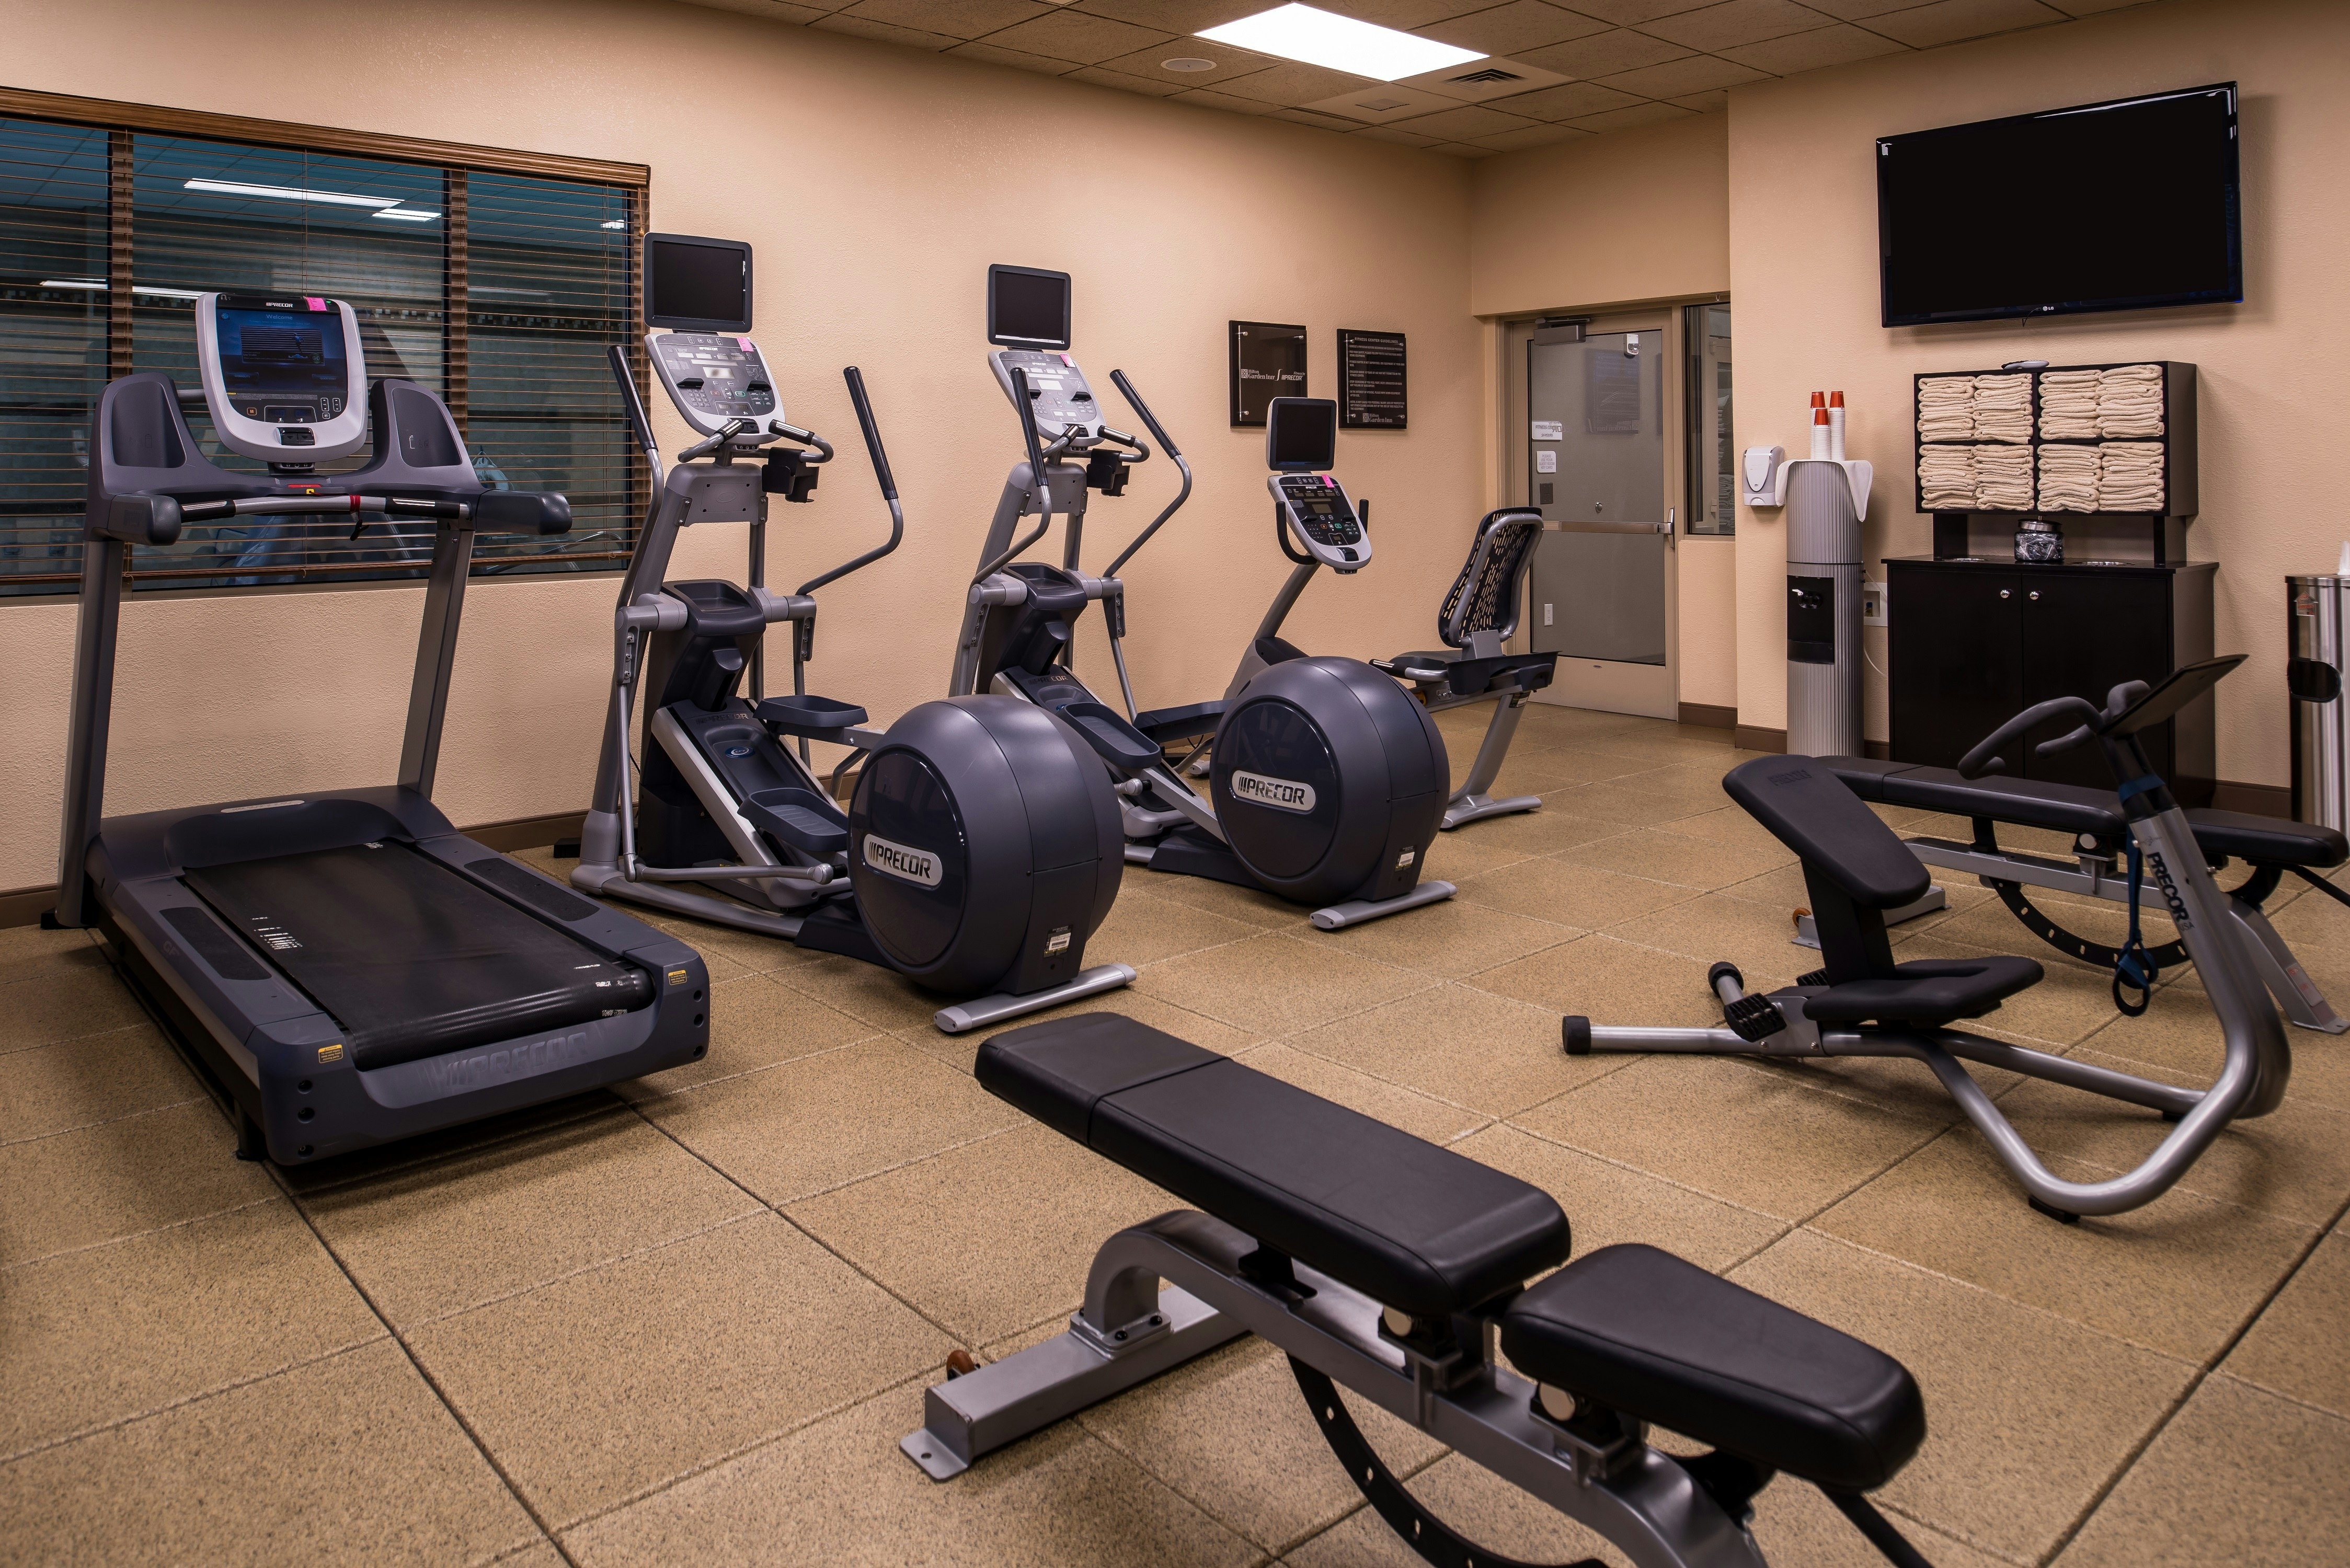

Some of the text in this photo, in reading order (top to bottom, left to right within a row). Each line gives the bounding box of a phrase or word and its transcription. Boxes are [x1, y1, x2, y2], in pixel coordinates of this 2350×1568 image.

[1246, 778, 1305, 805] PRECOR
[876, 844, 932, 879] PRECOR
[2147, 851, 2189, 923] PRECOR
[2180, 922, 2195, 931] USA
[467, 1032, 590, 1084] PRECOR
